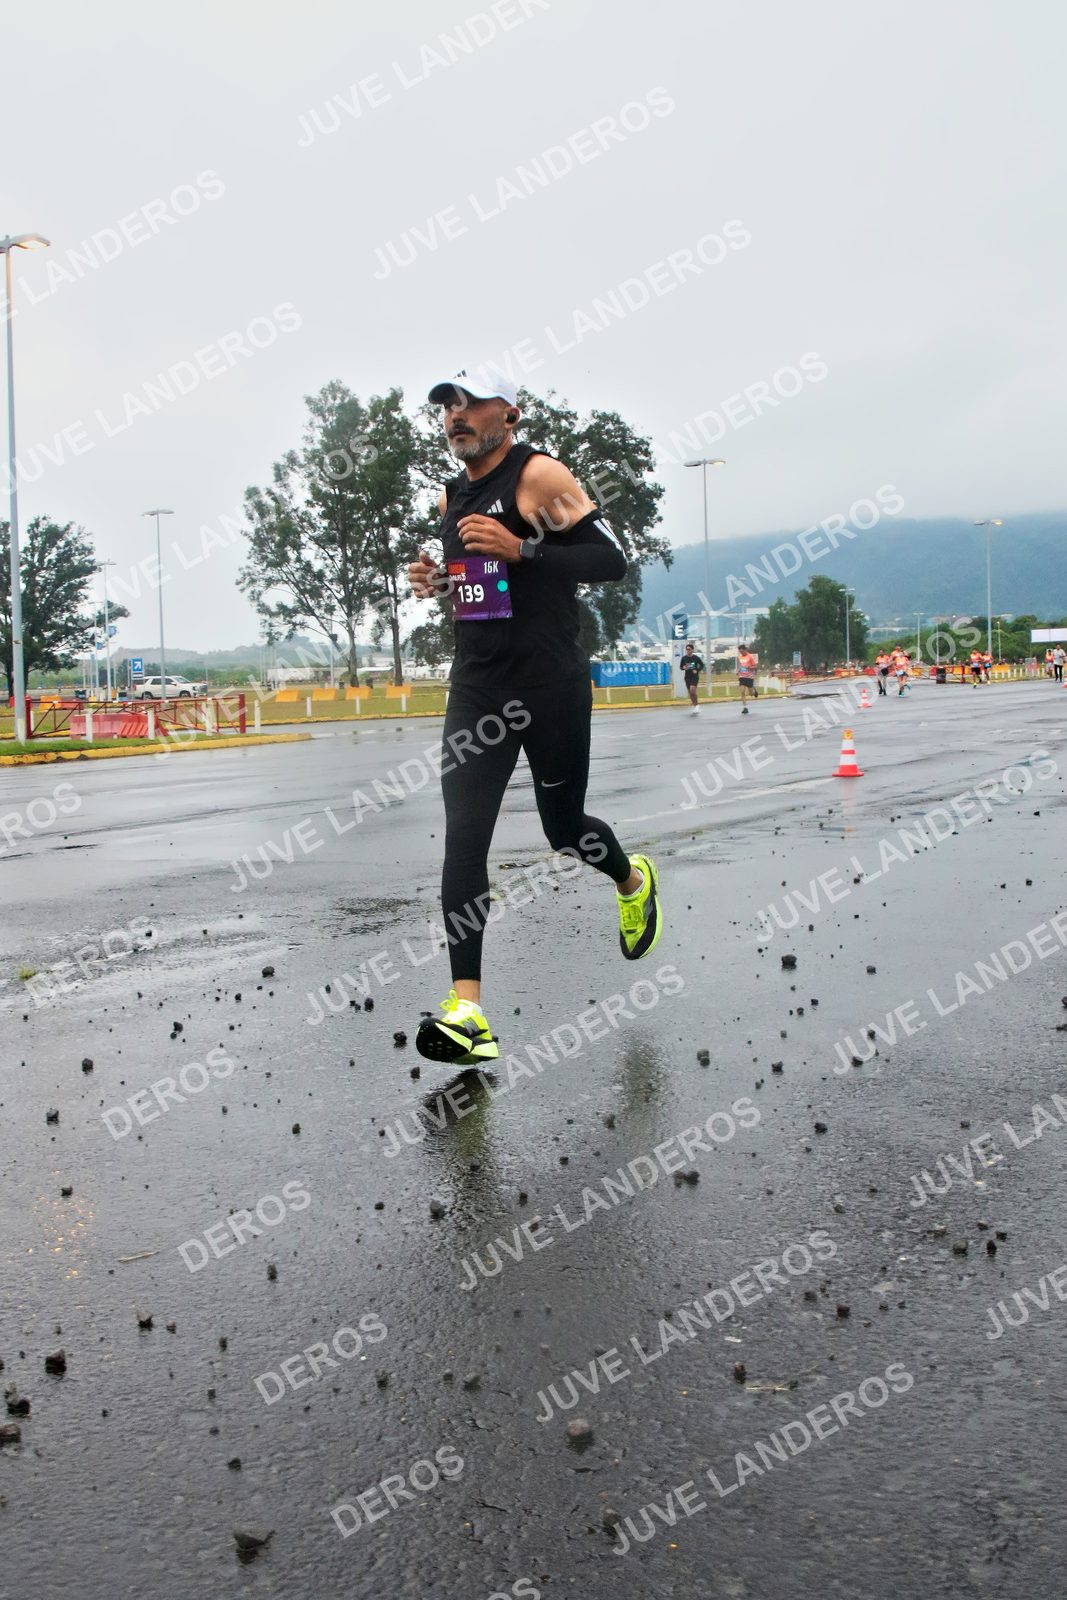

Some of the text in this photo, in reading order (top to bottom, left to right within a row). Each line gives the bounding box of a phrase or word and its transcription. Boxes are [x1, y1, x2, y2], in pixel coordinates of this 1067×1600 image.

[484, 560, 499, 574] 16K
[458, 584, 485, 603] 139
[674, 624, 684, 637] E
